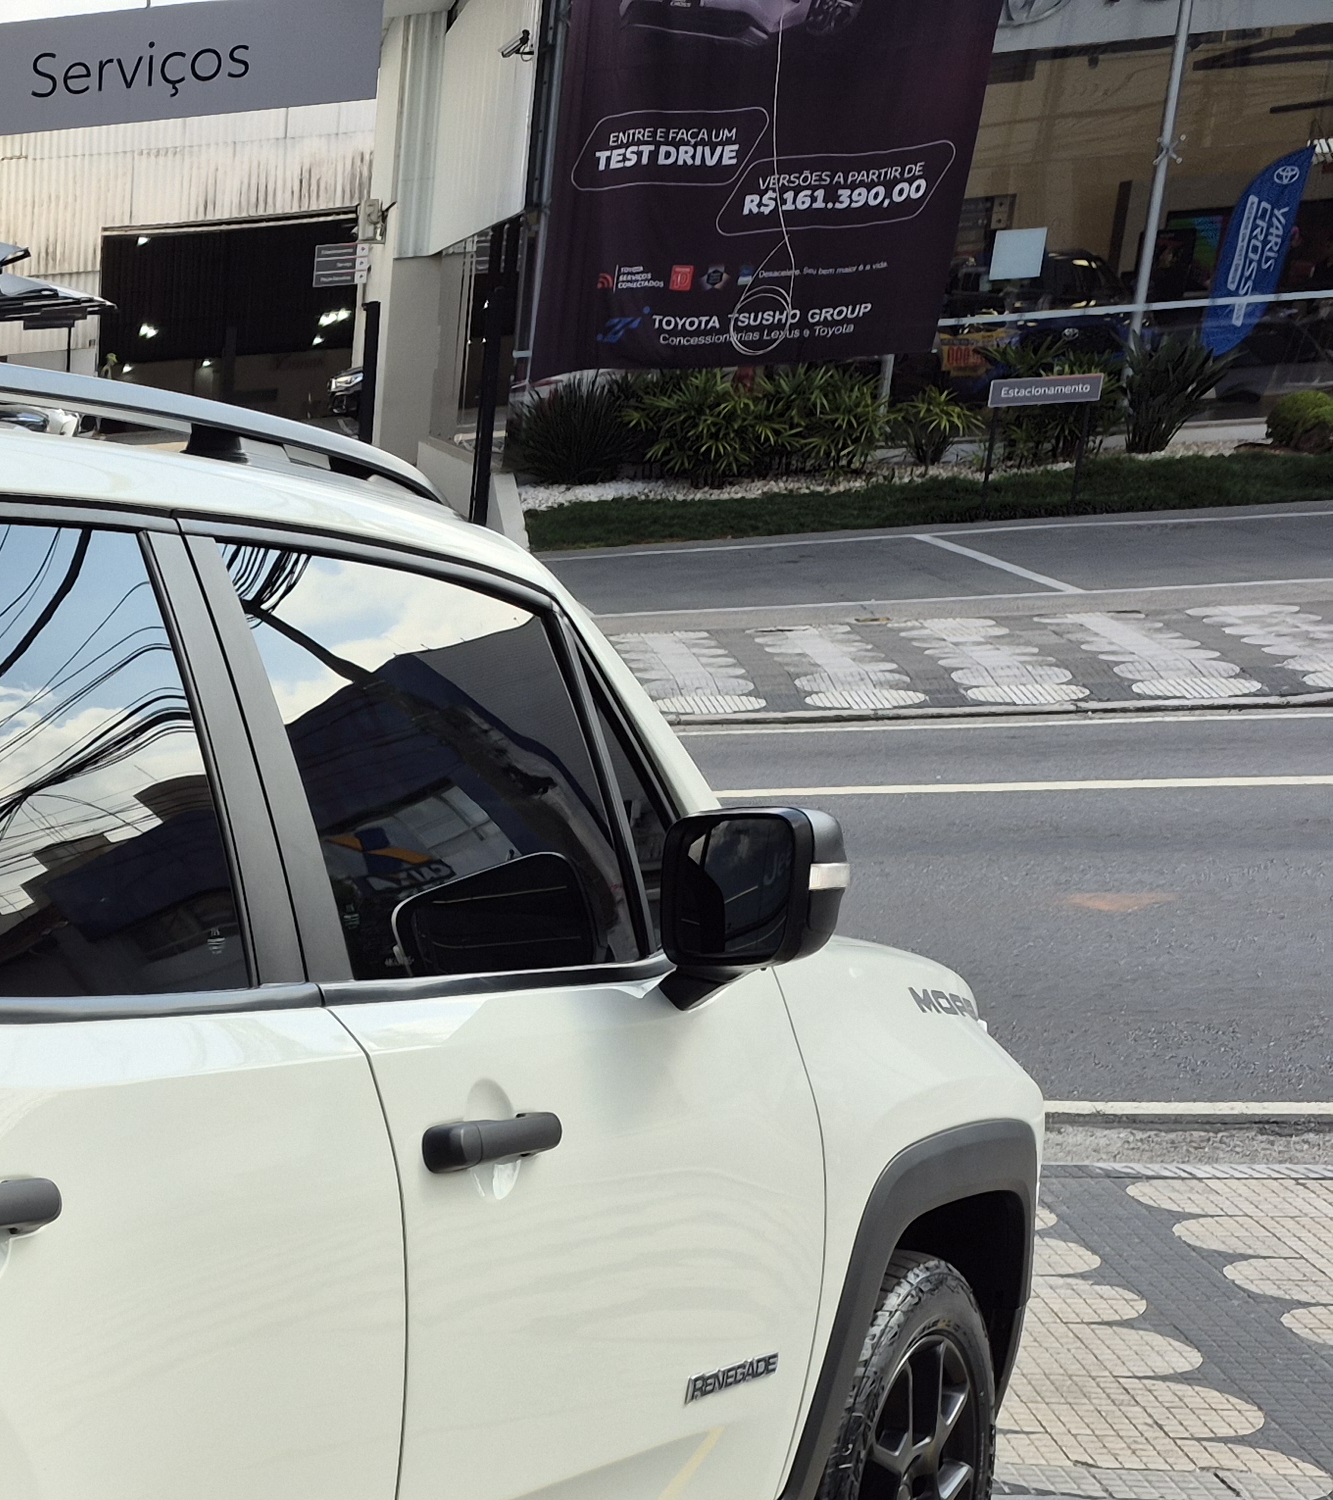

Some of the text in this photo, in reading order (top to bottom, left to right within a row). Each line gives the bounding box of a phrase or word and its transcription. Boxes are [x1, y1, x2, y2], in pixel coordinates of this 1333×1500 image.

[31, 41, 251, 98] Serviços
[609, 128, 737, 146] ENTRE E FAÇA UM
[595, 144, 740, 171] TEST DRIVE
[759, 162, 925, 189] VERSÕES A PARTIR DE
[742, 178, 927, 216] R$ 161.390,00
[1239, 200, 1272, 296] CROSS
[1261, 207, 1290, 272] YARIS
[652, 303, 872, 331] TOYOTA TSUSHO GROUP
[813, 321, 854, 337] Toyota
[1001, 384, 1091, 398] Estacionamento
[683, 1352, 779, 1406] RENEGADE
